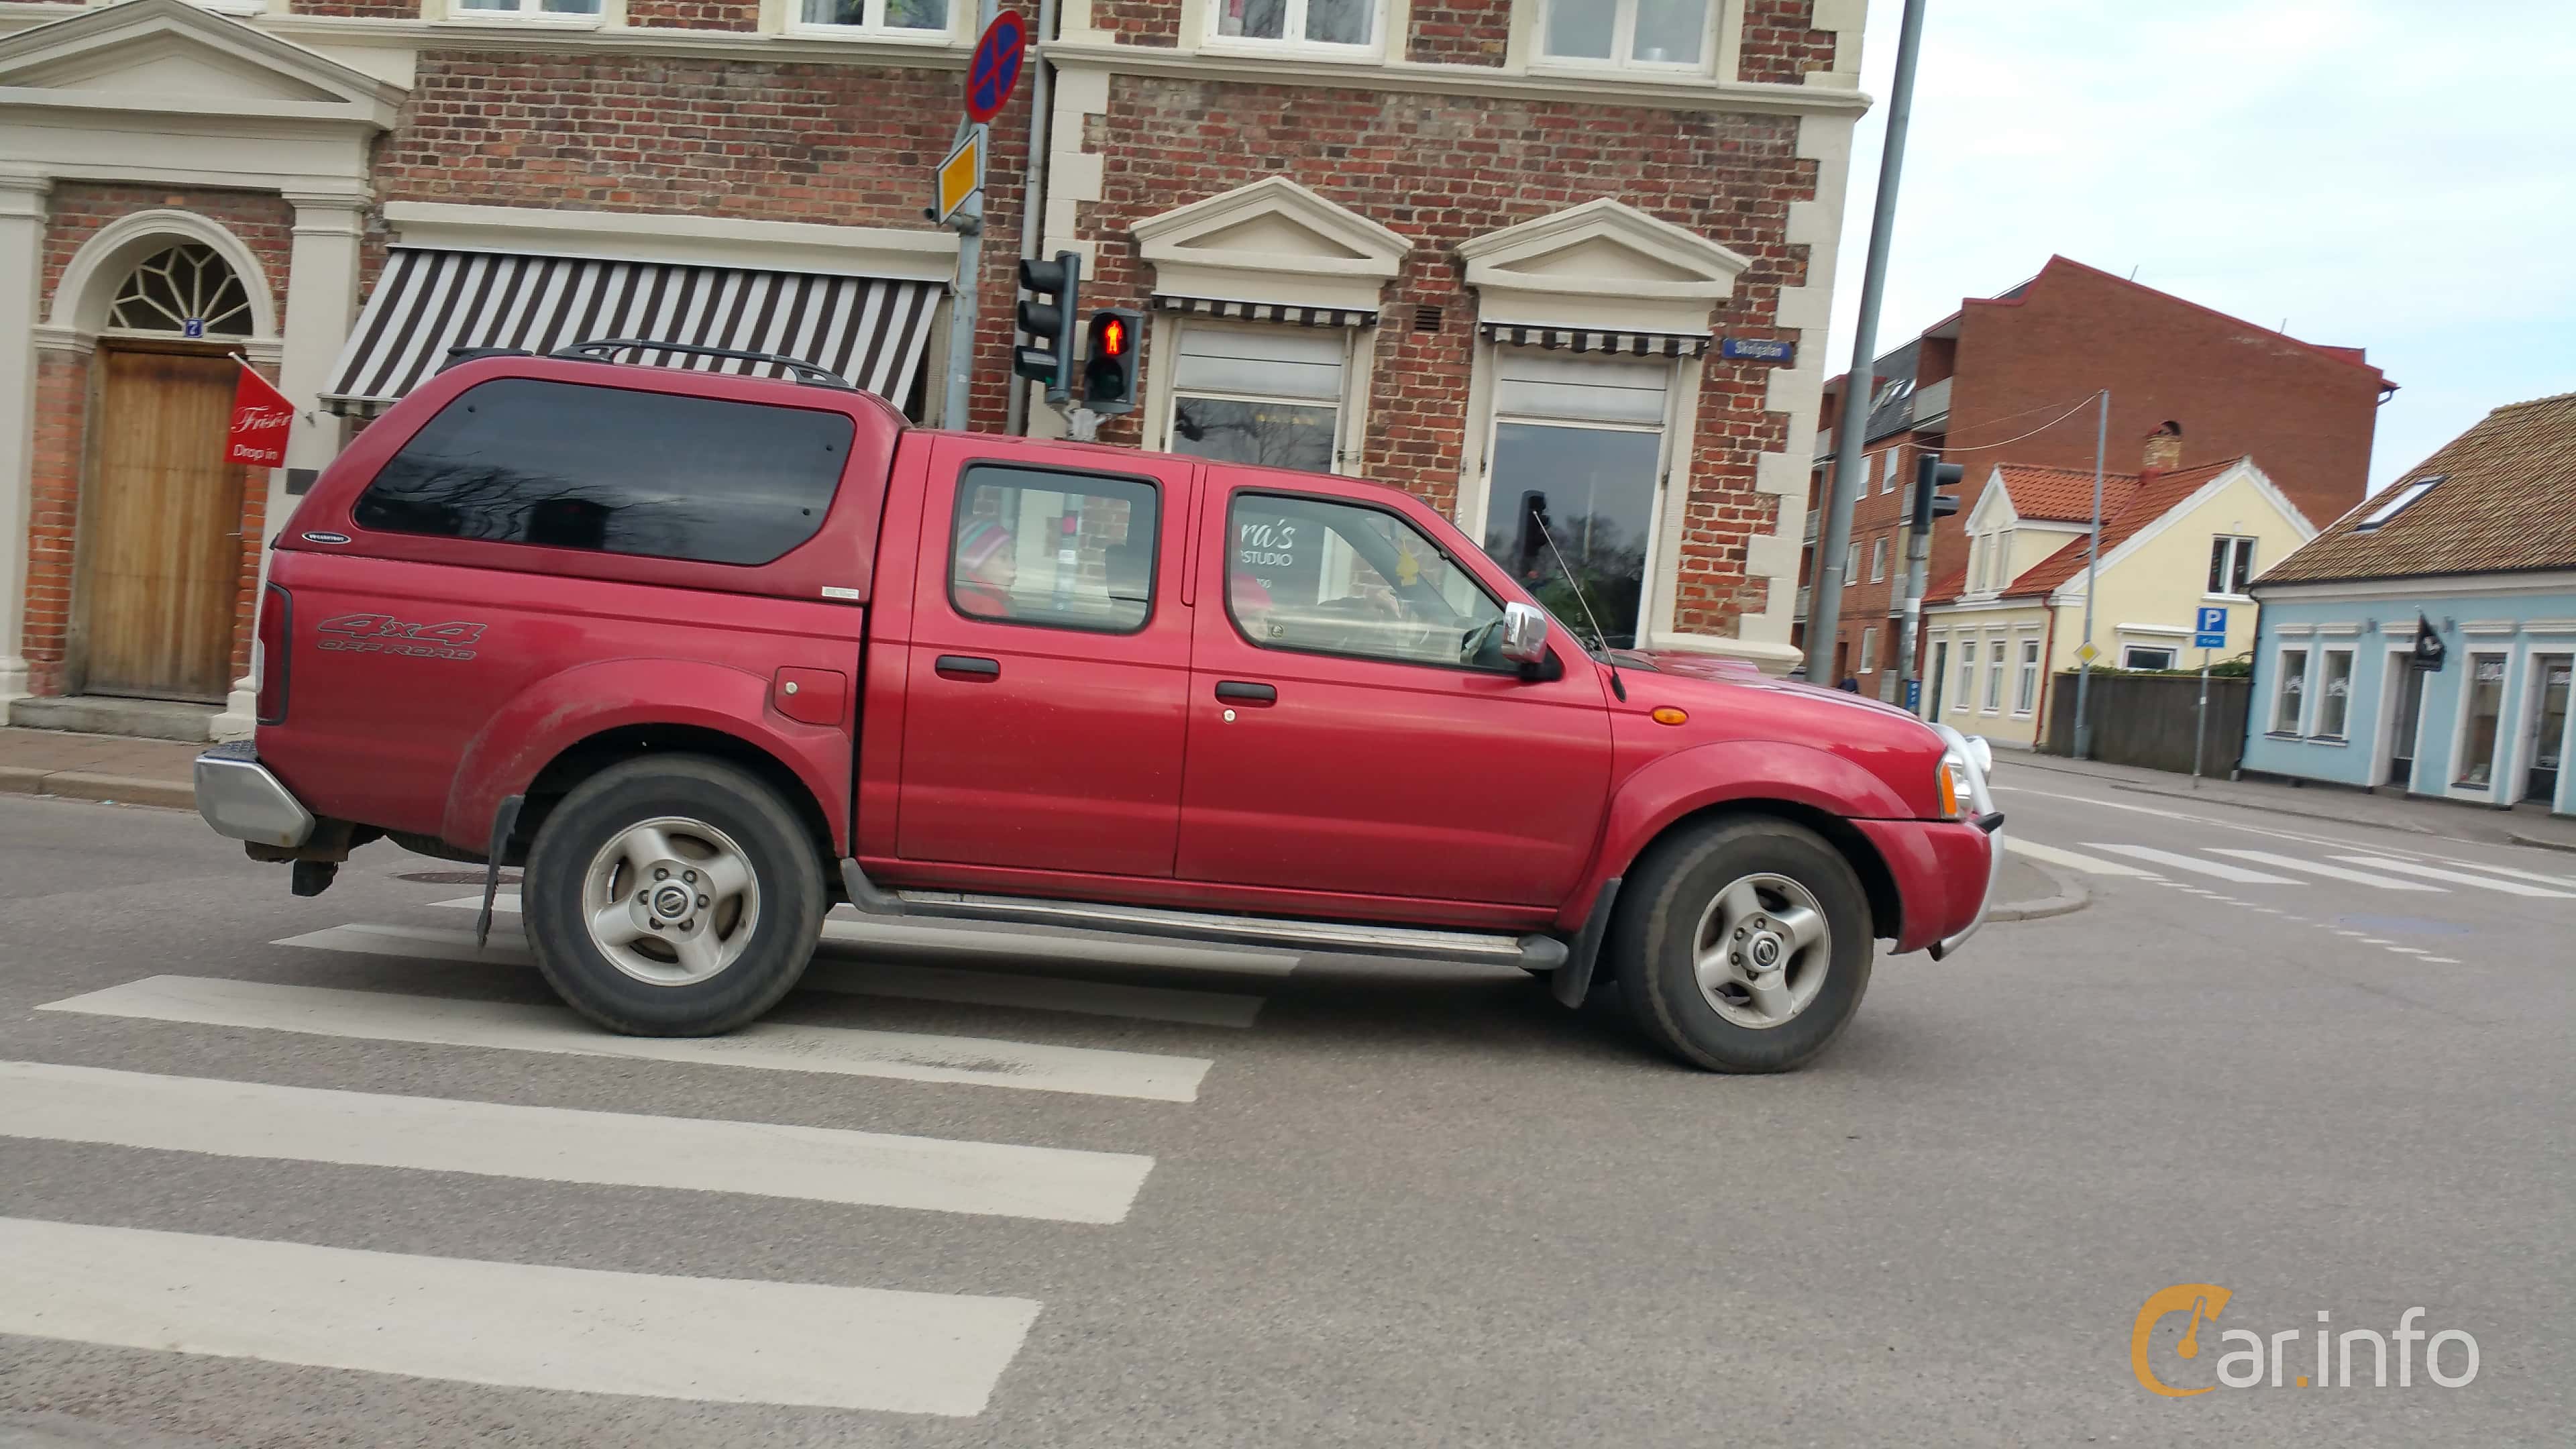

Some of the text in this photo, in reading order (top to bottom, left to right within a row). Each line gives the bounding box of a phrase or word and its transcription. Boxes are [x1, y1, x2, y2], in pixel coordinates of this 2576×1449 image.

[188, 321, 198, 335] 7
[233, 443, 278, 461] Drop in
[319, 613, 488, 646] 4x4
[2204, 610, 2222, 630] P
[317, 639, 477, 659] OFF ROAD
